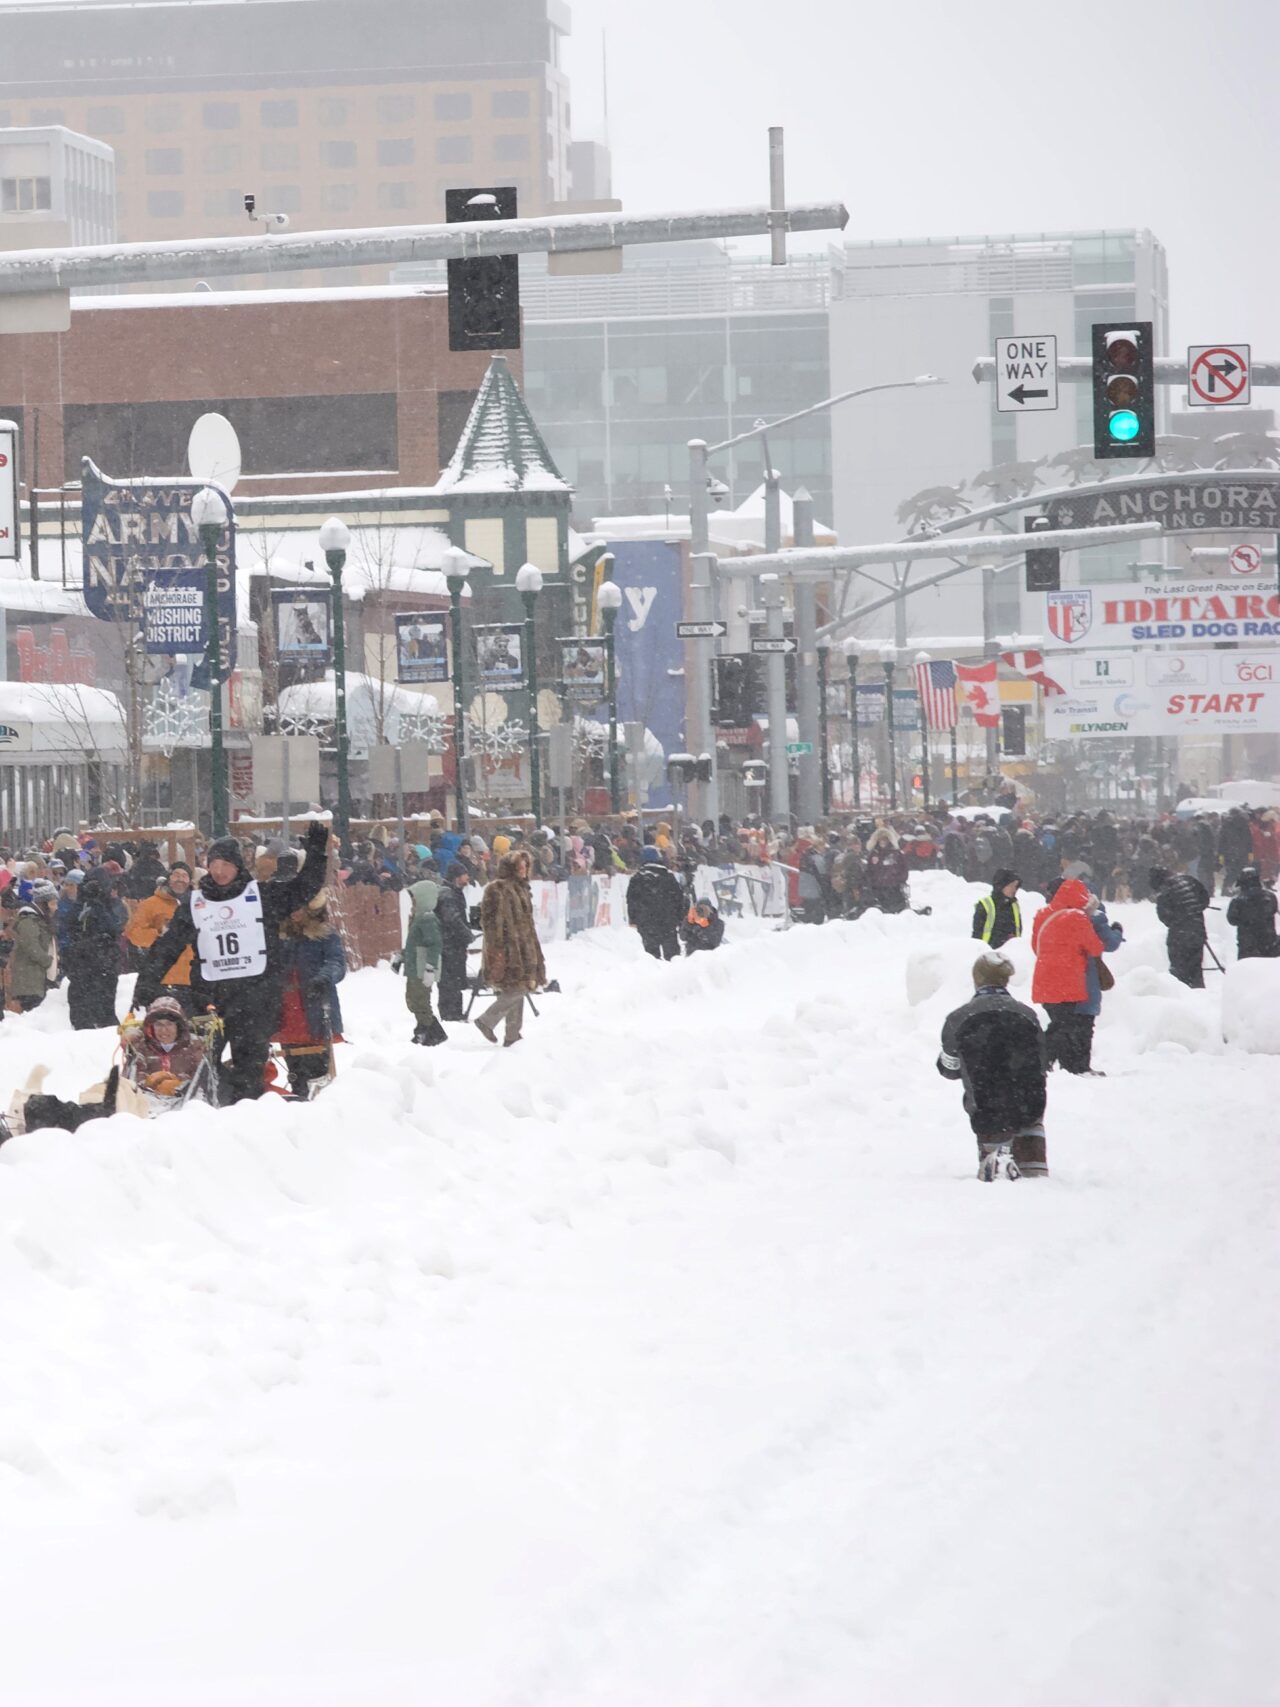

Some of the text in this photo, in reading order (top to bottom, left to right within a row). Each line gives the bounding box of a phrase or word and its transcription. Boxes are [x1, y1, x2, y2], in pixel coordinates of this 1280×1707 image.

[1007, 342, 1047, 360] ONE
[1006, 362, 1048, 380] WAY
[1093, 486, 1278, 521] ANCHORA
[87, 512, 200, 545] ARMY
[1187, 585, 1213, 593] Great
[1216, 584, 1239, 592] Race
[147, 607, 202, 626] MUSHING
[146, 625, 202, 643] DISTRICT
[1131, 624, 1186, 640] SLED
[1192, 622, 1238, 637] DOG
[1238, 665, 1273, 682] GCI
[1166, 692, 1266, 715] START
[1081, 721, 1129, 733] LYNDEN
[216, 932, 239, 956] 16
